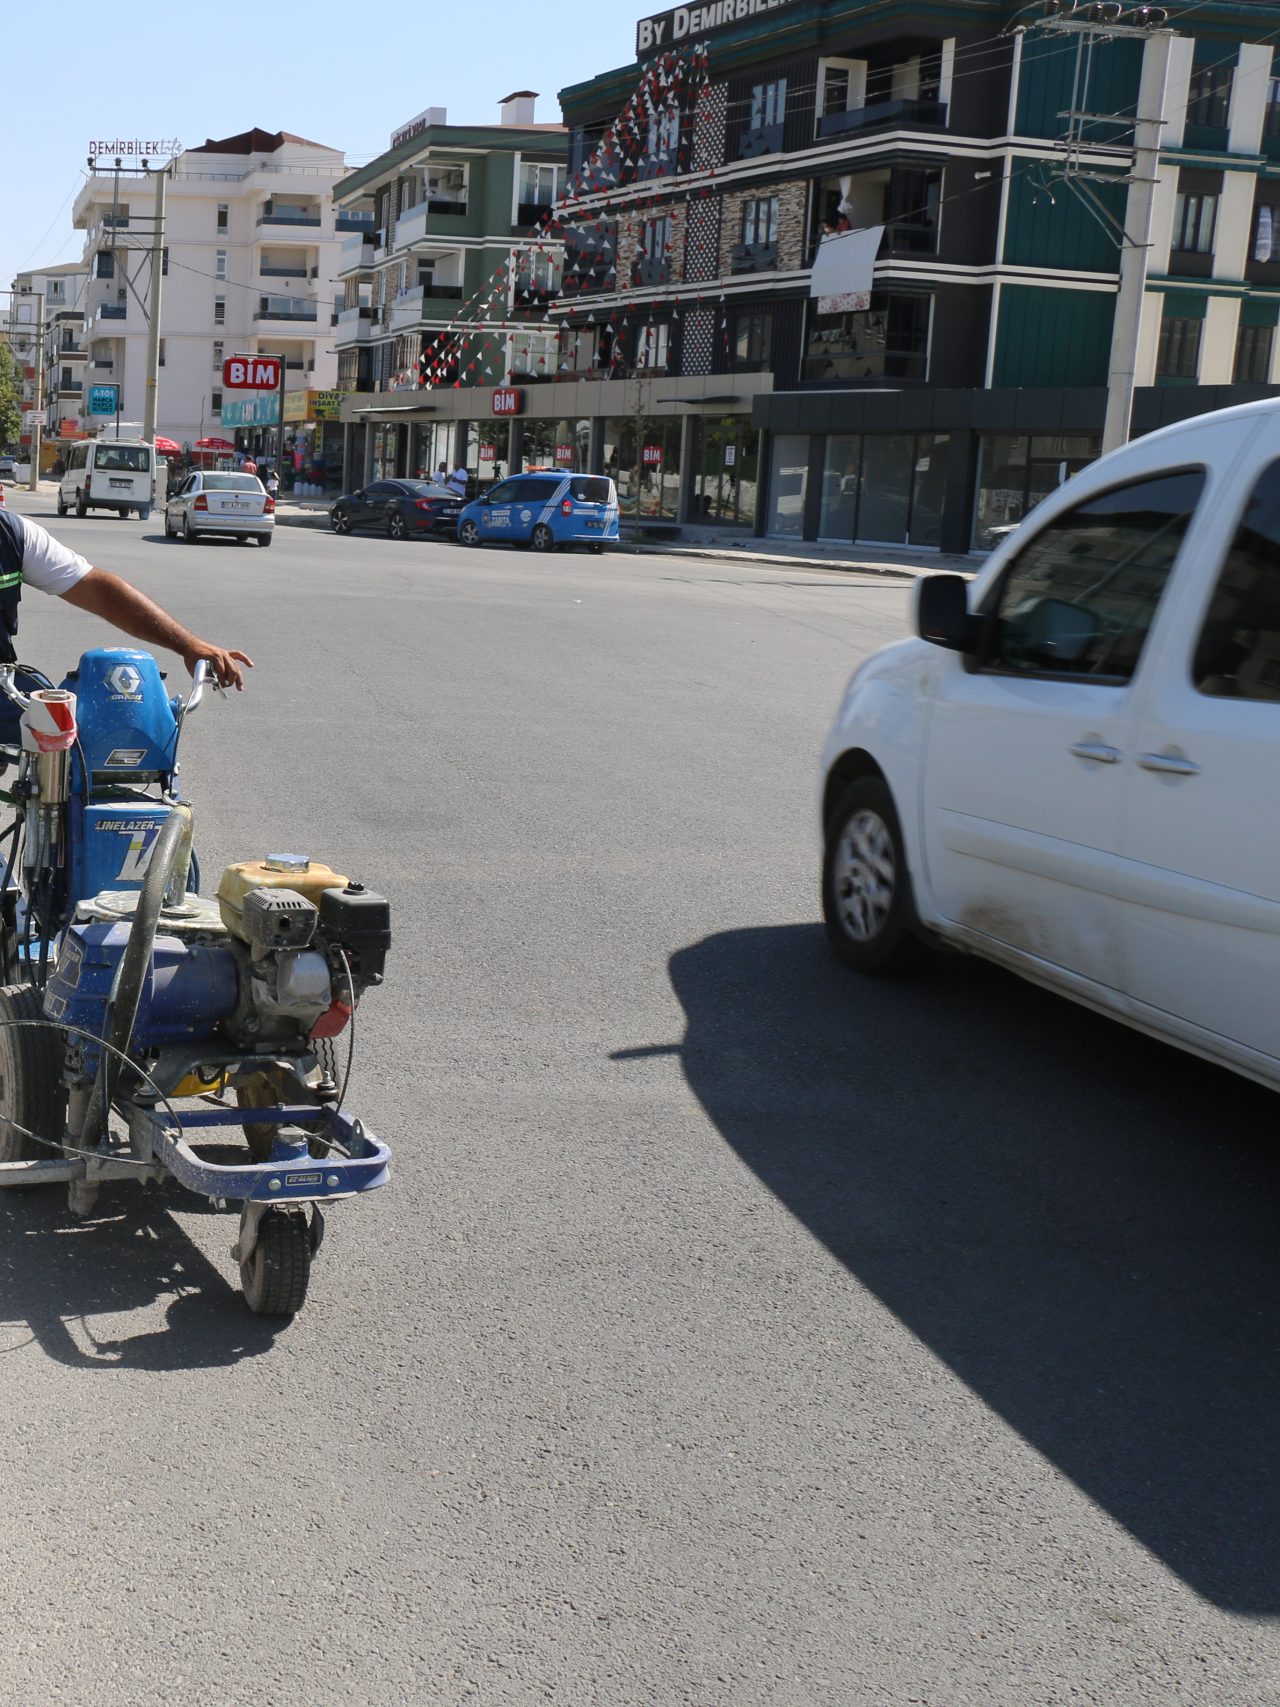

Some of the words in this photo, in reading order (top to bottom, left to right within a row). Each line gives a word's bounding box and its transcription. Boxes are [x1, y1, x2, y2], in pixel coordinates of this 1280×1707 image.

[89, 138, 160, 155] DEMİRBİLEK
[230, 360, 275, 385] BİM
[494, 389, 515, 411] BİM
[480, 446, 493, 458] BİM
[556, 446, 571, 459] BİM
[643, 447, 661, 461] BİM
[95, 821, 155, 831] LINELAZER
